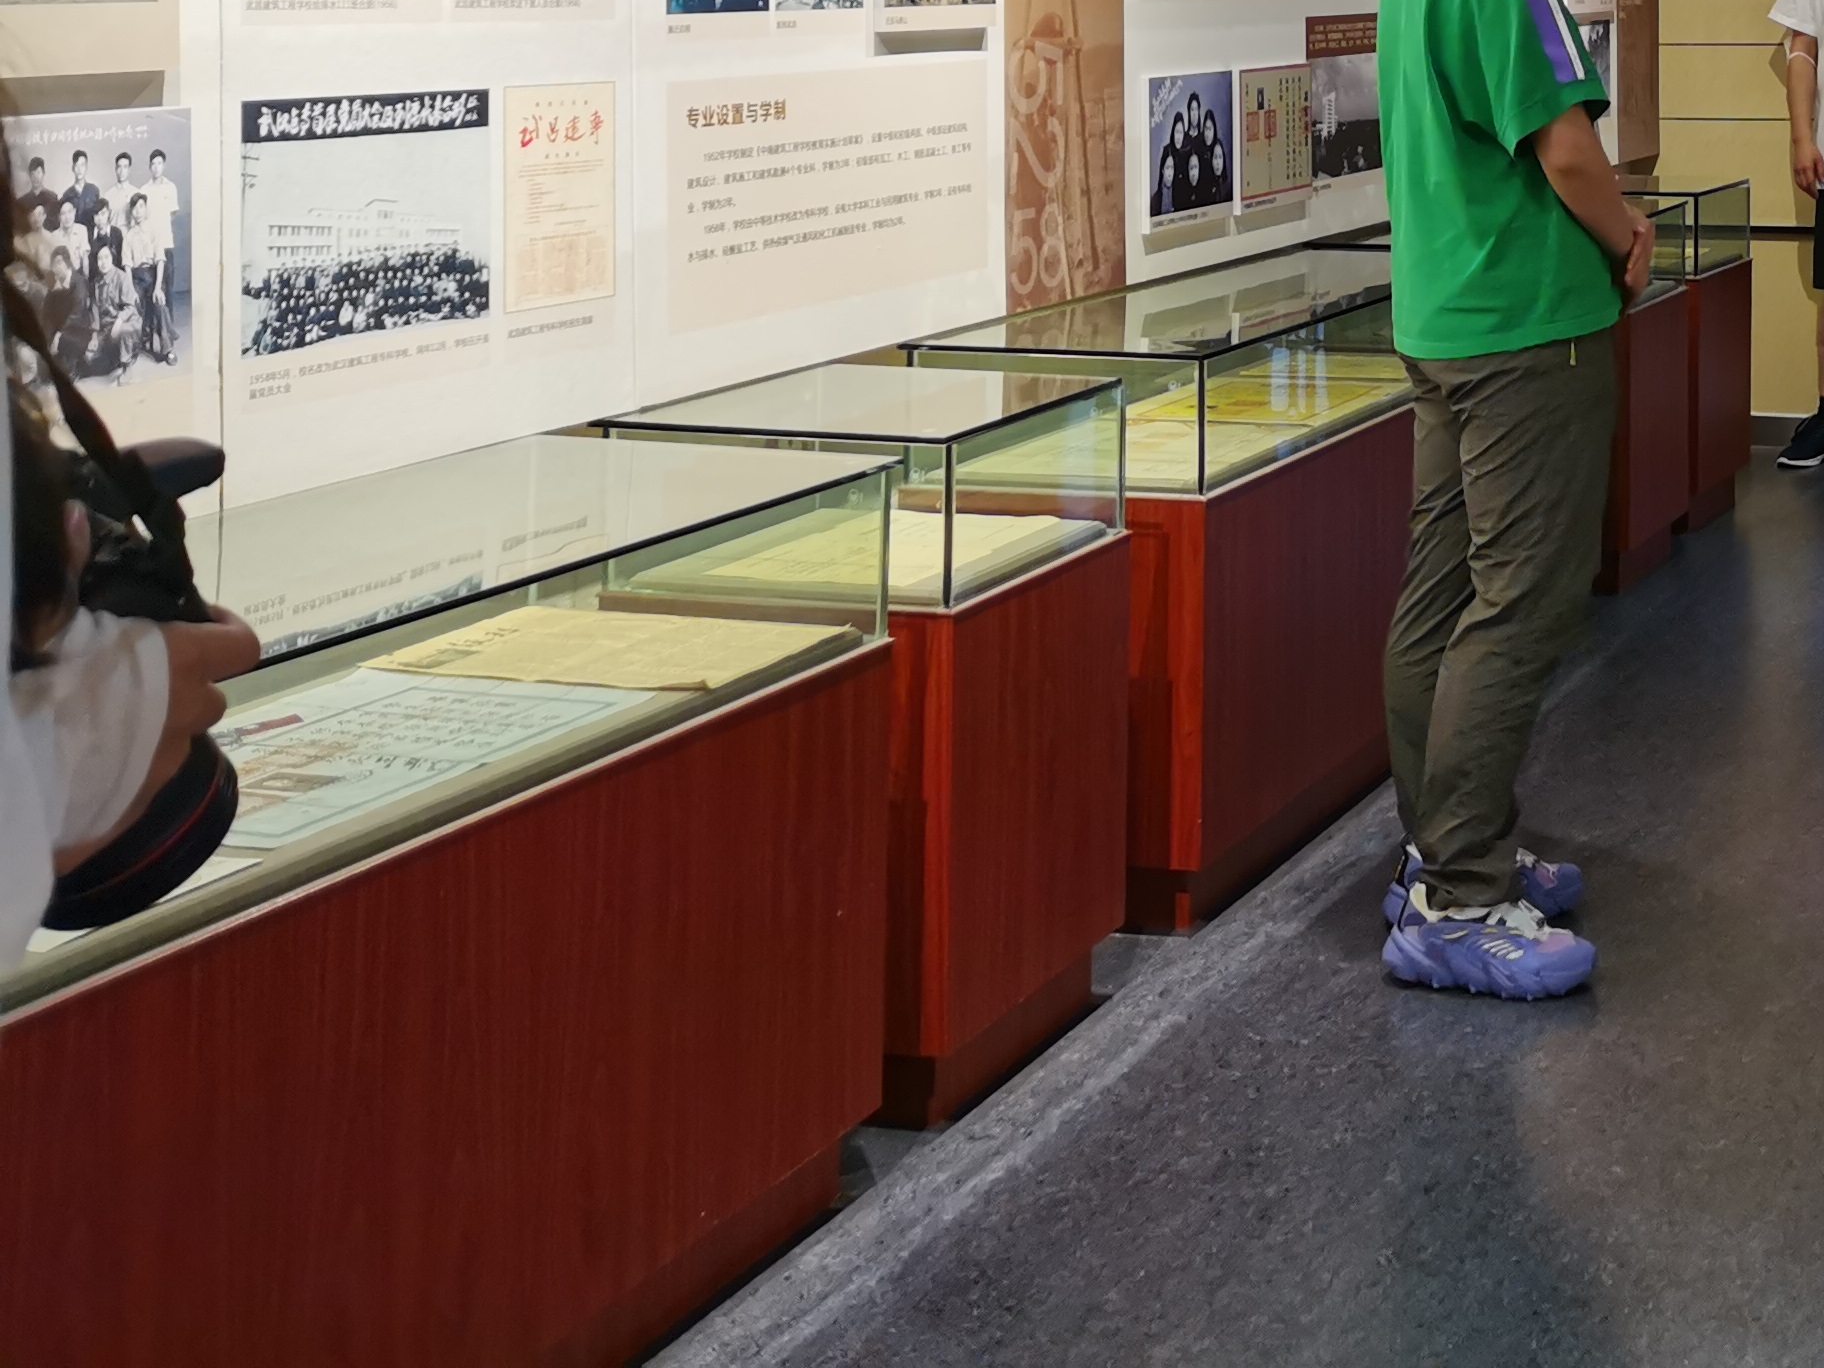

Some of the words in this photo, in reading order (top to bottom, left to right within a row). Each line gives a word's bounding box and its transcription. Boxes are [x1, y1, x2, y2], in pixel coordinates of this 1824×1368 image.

[686, 99, 787, 130] 专业设置与学制
